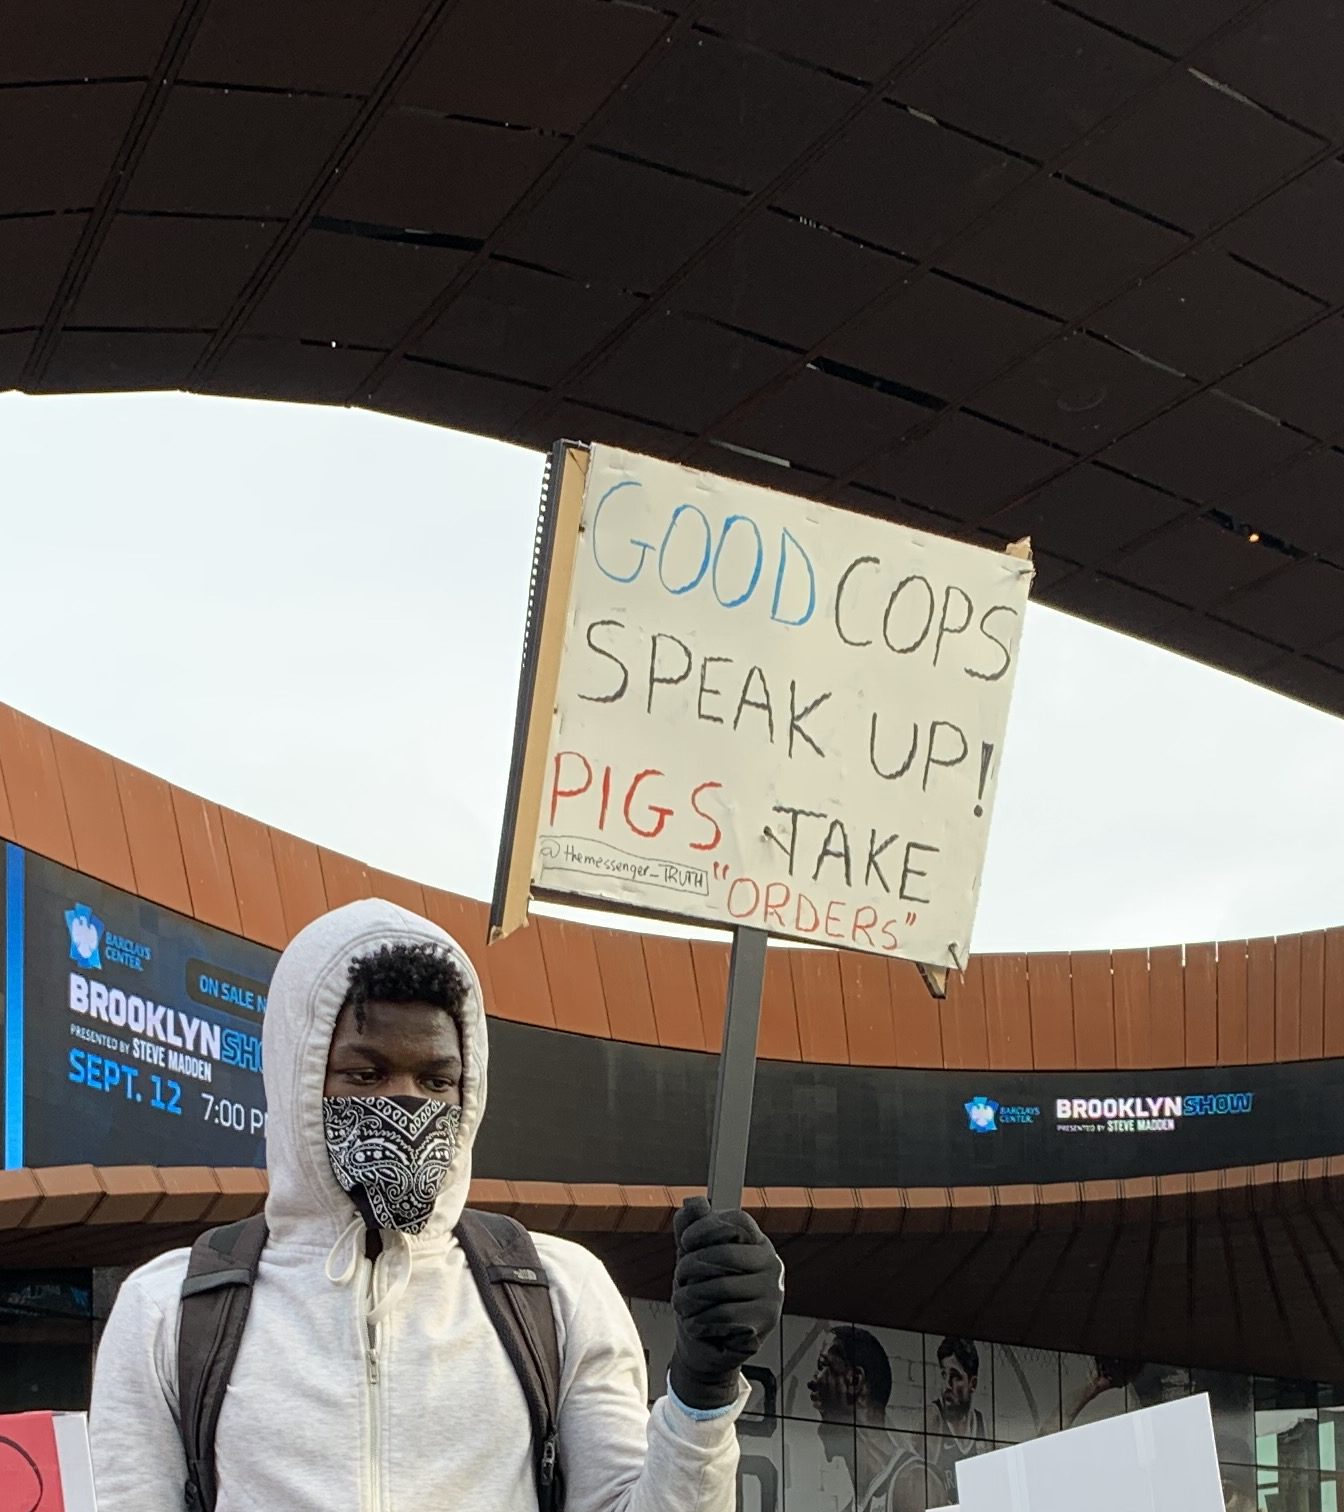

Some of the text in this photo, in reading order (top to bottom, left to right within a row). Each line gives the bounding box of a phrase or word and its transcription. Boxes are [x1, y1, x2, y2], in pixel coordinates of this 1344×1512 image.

[592, 480, 1019, 682] GOOD COPS
[577, 619, 995, 818] SPEAK UP!
[549, 750, 940, 904] PIGS TAKE
[713, 861, 917, 951] "ORDERS"
[106, 930, 152, 962] BARCLAYS
[199, 974, 220, 994] ON
[221, 982, 254, 1011] SALE
[67, 1048, 142, 1103] SEPT.
[149, 1074, 183, 1115] 12
[201, 1092, 246, 1132] 7:00
[70, 1024, 212, 1084] PRESENTED BY STEVE MADDEN
[1000, 1106, 1041, 1116] BARCLAYS
[1056, 1124, 1096, 1132] PRESENTED
[1106, 1119, 1136, 1132] STEVE
[1137, 1118, 1175, 1132] MADDEN
